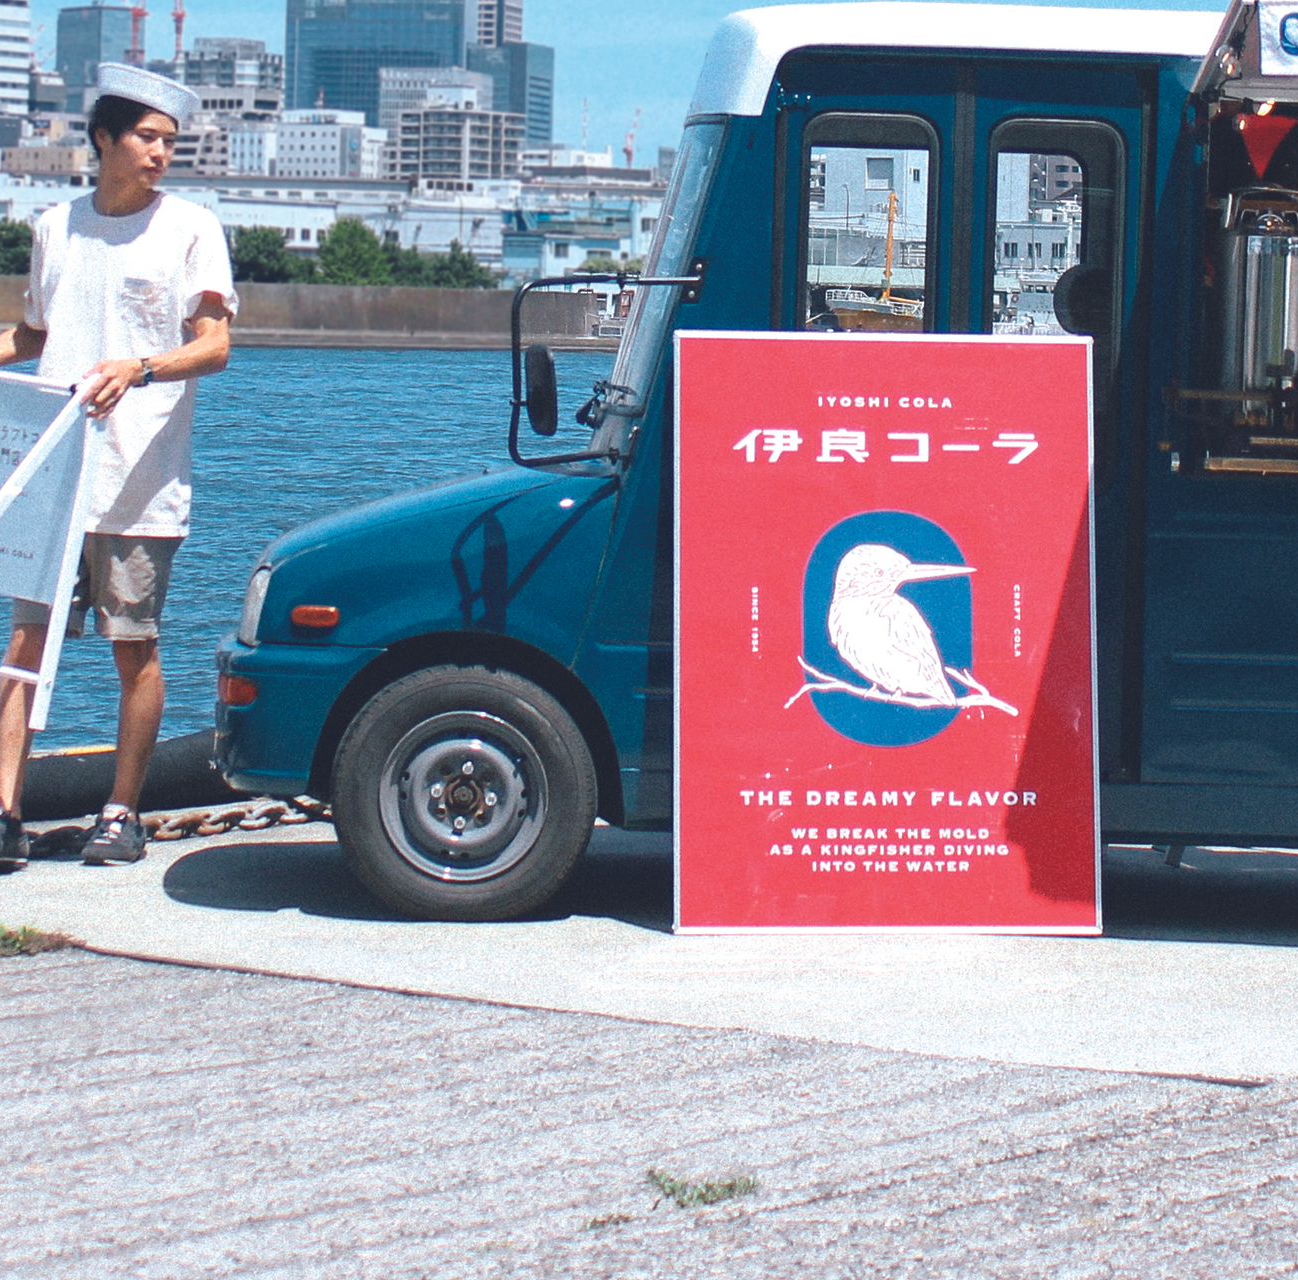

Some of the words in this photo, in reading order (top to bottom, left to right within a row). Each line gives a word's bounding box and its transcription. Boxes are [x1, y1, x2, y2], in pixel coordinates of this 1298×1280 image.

[817, 396, 889, 408] IYOSHI
[898, 396, 953, 409] COLA
[732, 427, 1039, 465] 伊良コーラ
[751, 586, 759, 620] SINCE
[1013, 584, 1021, 620] CRAFT
[1013, 628, 1021, 657] COLA
[739, 790, 793, 806] THE
[806, 790, 916, 806] DREAMY
[931, 790, 1037, 806] FLAVOR
[790, 827, 819, 840] WE
[826, 827, 888, 840] BREAK
[894, 827, 931, 840] THE
[938, 827, 990, 840] MOLD
[769, 844, 794, 856] AS
[800, 844, 812, 856] A
[820, 844, 936, 856] KINGFISHER
[943, 844, 1009, 856] DIVING
[811, 860, 856, 872] INTO
[862, 860, 899, 872] THE
[905, 860, 970, 873] WATER
